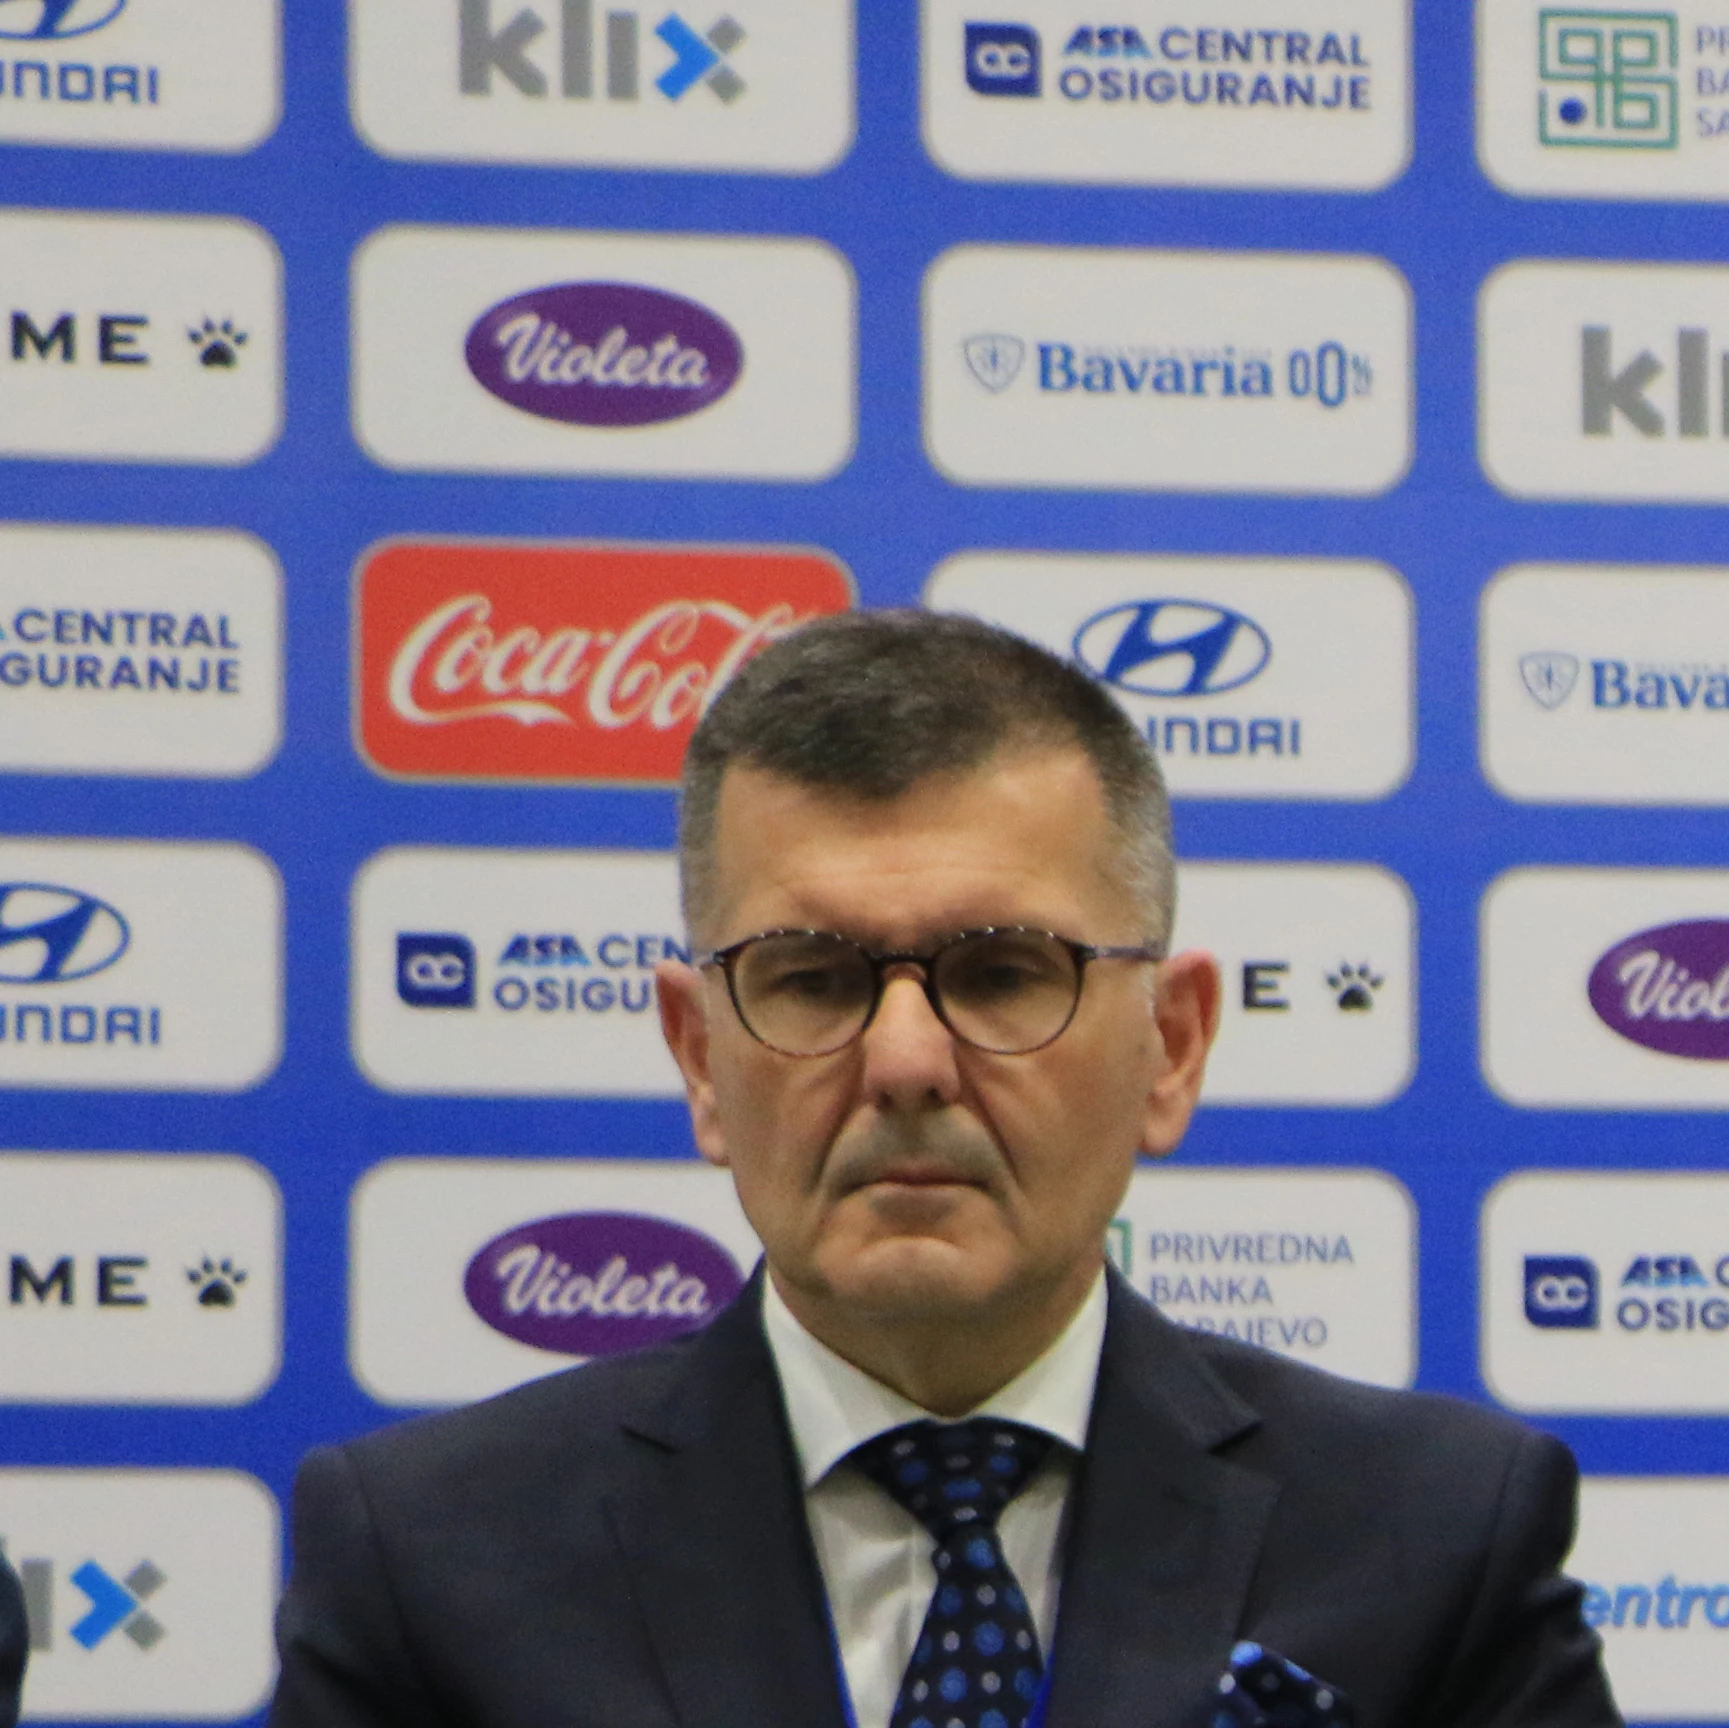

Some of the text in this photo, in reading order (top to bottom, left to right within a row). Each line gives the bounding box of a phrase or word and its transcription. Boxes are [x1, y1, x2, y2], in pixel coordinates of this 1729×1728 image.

[1159, 28, 1368, 67] CENTRAL
[0, 60, 157, 103] NDAI
[1058, 66, 1369, 110] OSIGURANJE
[498, 312, 708, 390] Violeta
[1037, 343, 1273, 396] Bavaria
[13, 609, 237, 650] CENTRAL
[0, 1003, 161, 1046] NDAI
[1151, 1234, 1353, 1263] PRIVREDNA
[497, 1245, 708, 1318] Violeta
[1151, 1275, 1273, 1303] BANKA
